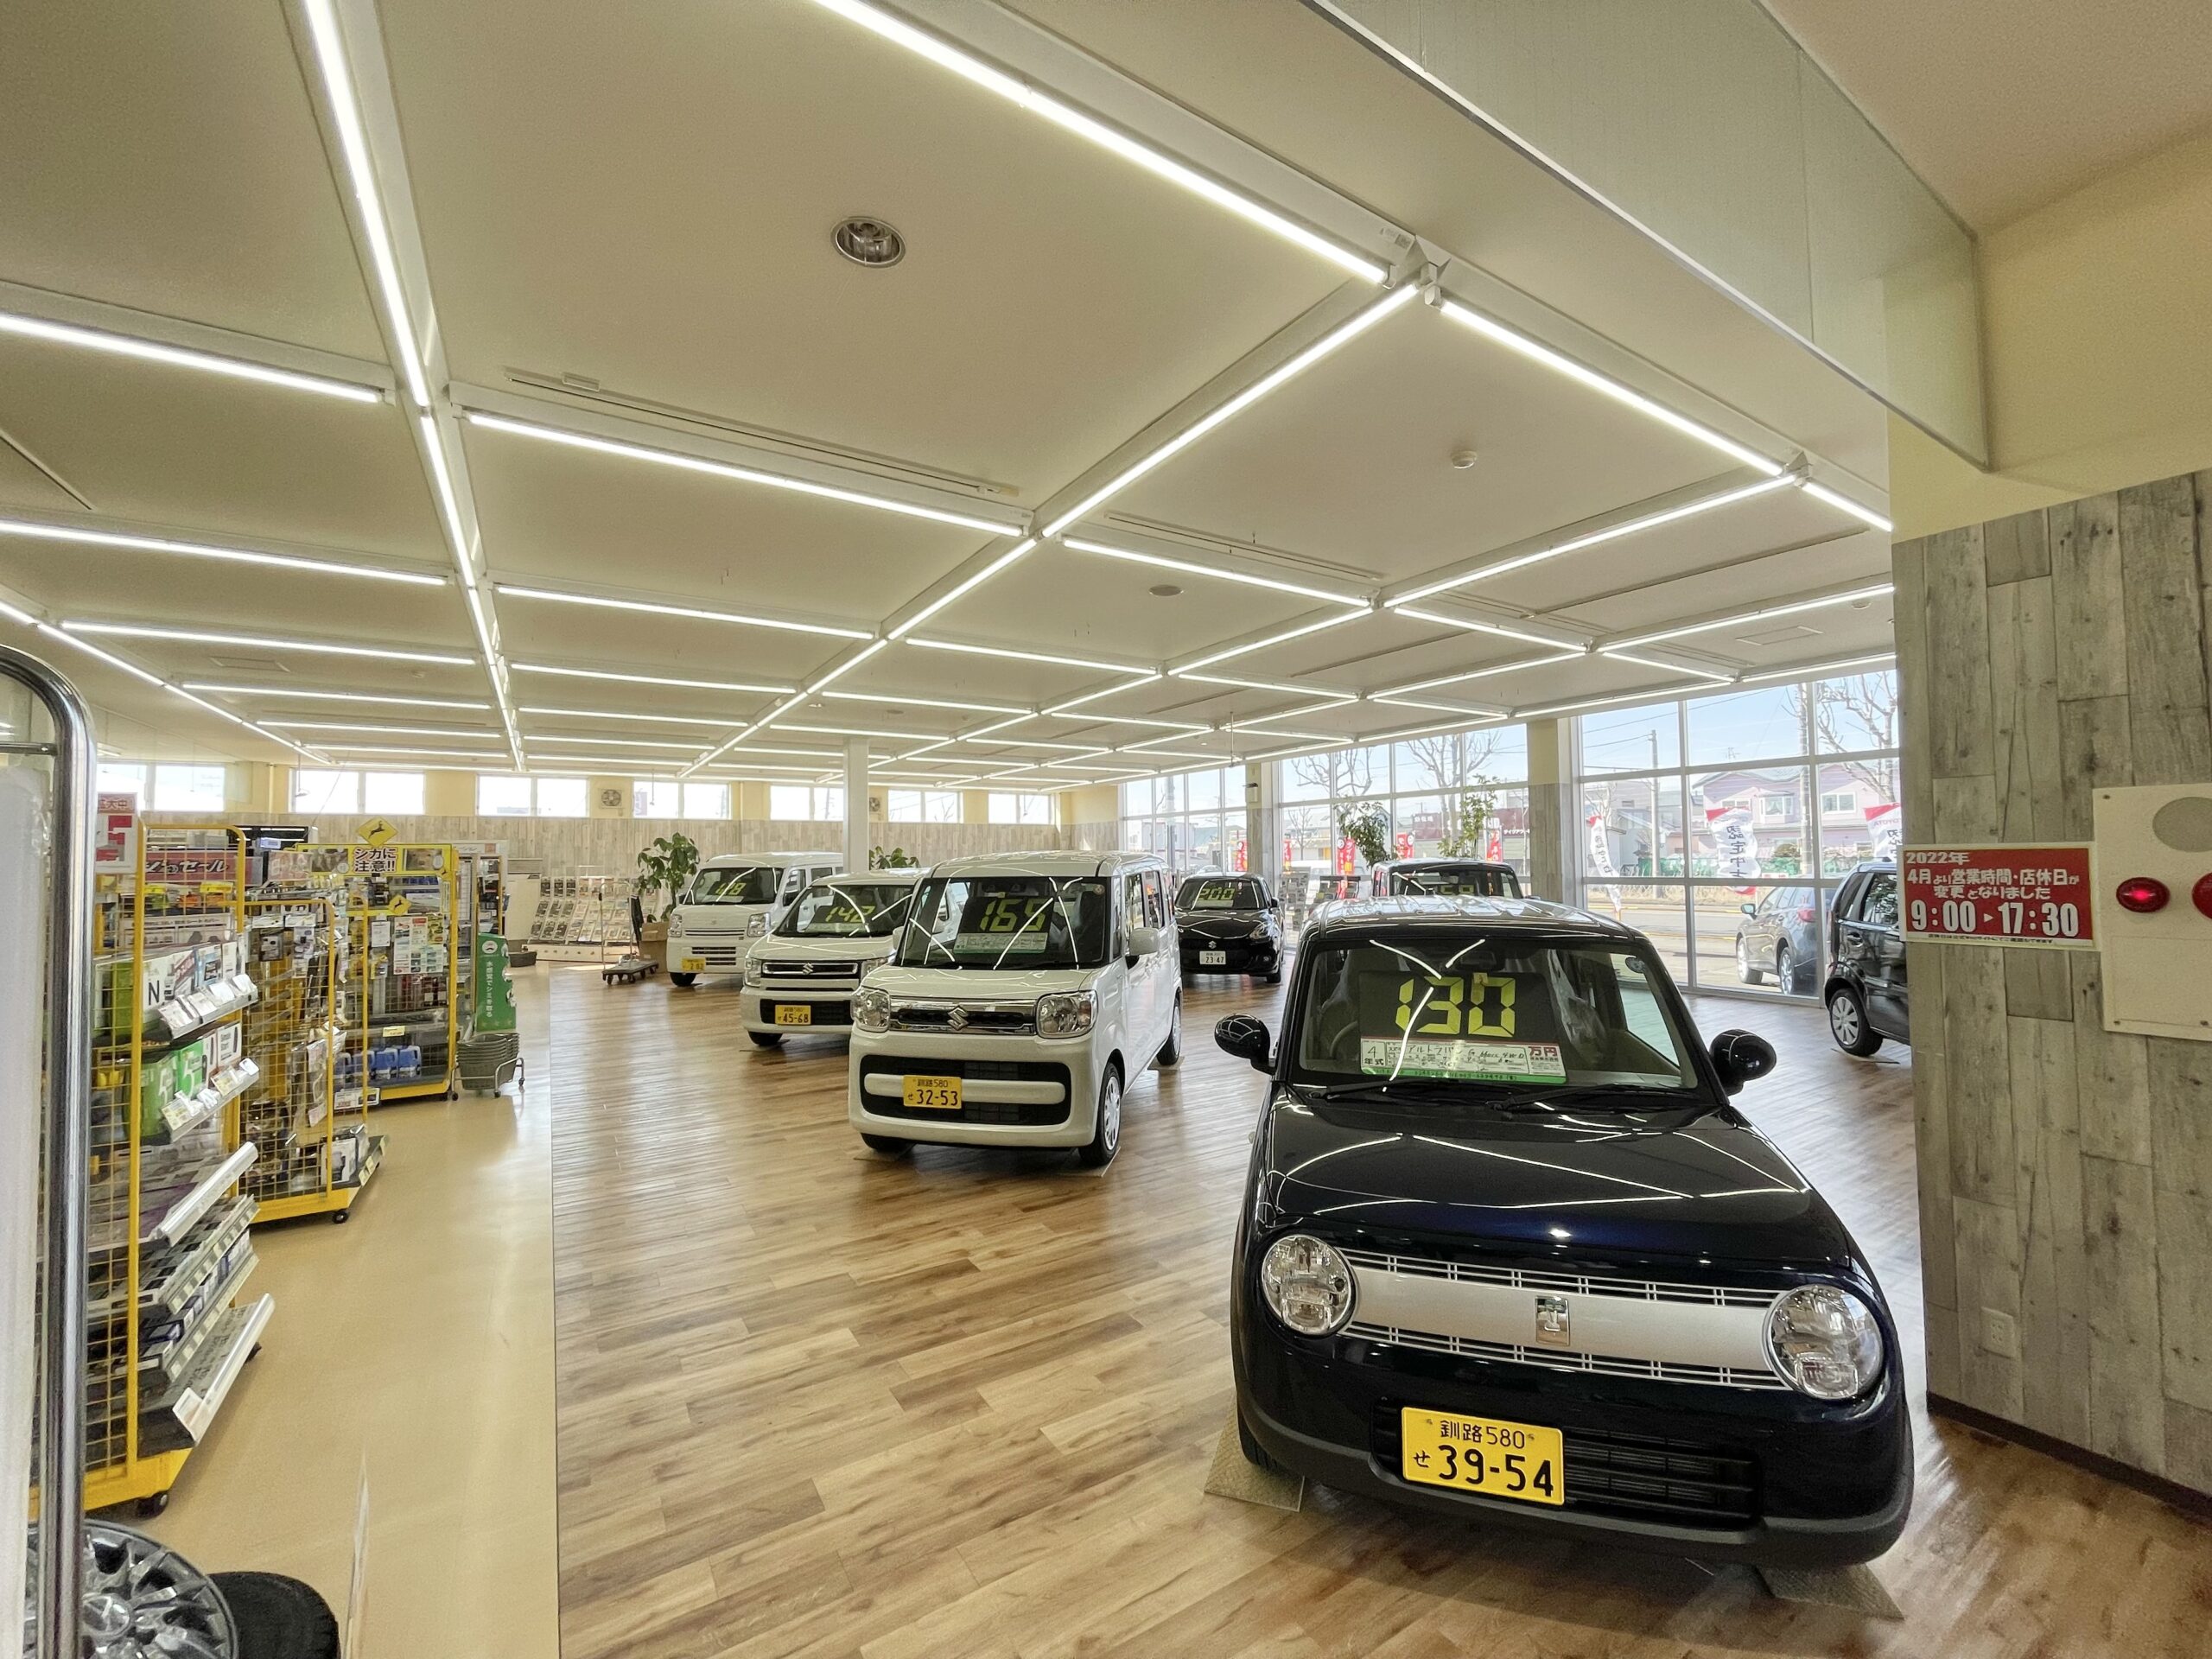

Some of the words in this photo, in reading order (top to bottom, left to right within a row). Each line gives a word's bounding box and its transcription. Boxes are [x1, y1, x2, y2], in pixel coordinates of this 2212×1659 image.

[354, 847, 397, 860] シカに
[1905, 851, 1971, 865] 2022年
[1932, 886, 2051, 900] 変更となりました
[1910, 900, 1977, 933] 9:00
[1998, 901, 2080, 938] 17:30
[1395, 976, 1516, 1038] 130
[1529, 1046, 1559, 1058] 万円
[916, 1089, 958, 1106] 32-53
[1413, 1450, 1431, 1468] せ
[1438, 1444, 1554, 1497] 39-54
